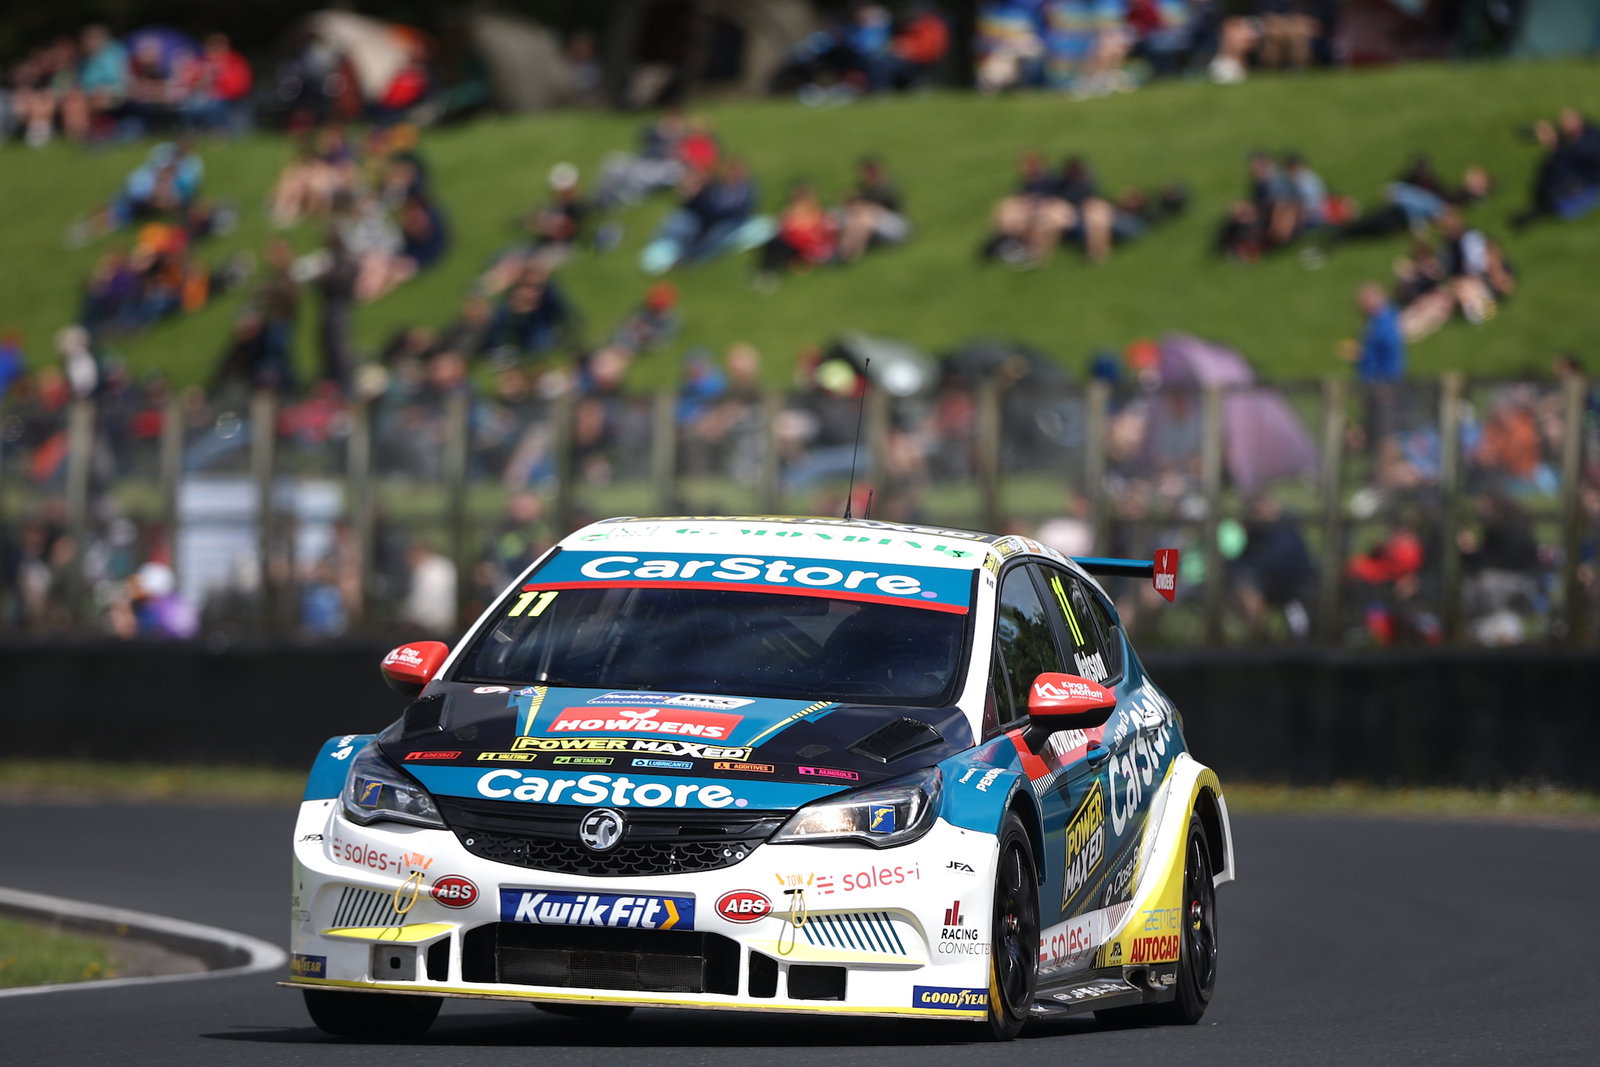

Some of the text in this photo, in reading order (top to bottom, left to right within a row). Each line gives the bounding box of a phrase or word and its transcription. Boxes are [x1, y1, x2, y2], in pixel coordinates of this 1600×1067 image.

[507, 591, 559, 617] 11
[554, 719, 726, 738] HOWDENS
[517, 739, 745, 759] POWER MAXED
[573, 757, 607, 765] DETAILING
[647, 760, 691, 769] LUBRICANTS
[733, 763, 769, 772] ADDITIVES
[1067, 792, 1104, 867] POWER
[344, 843, 403, 875] sales-i
[945, 861, 976, 873] JFA
[1064, 825, 1104, 901] MAXED
[786, 874, 804, 888] TOW
[842, 862, 921, 892] sales-i
[436, 883, 473, 901] ABS
[723, 897, 767, 915] ABS
[941, 928, 978, 941] RACING
[1130, 934, 1180, 963] AUTOCAR
